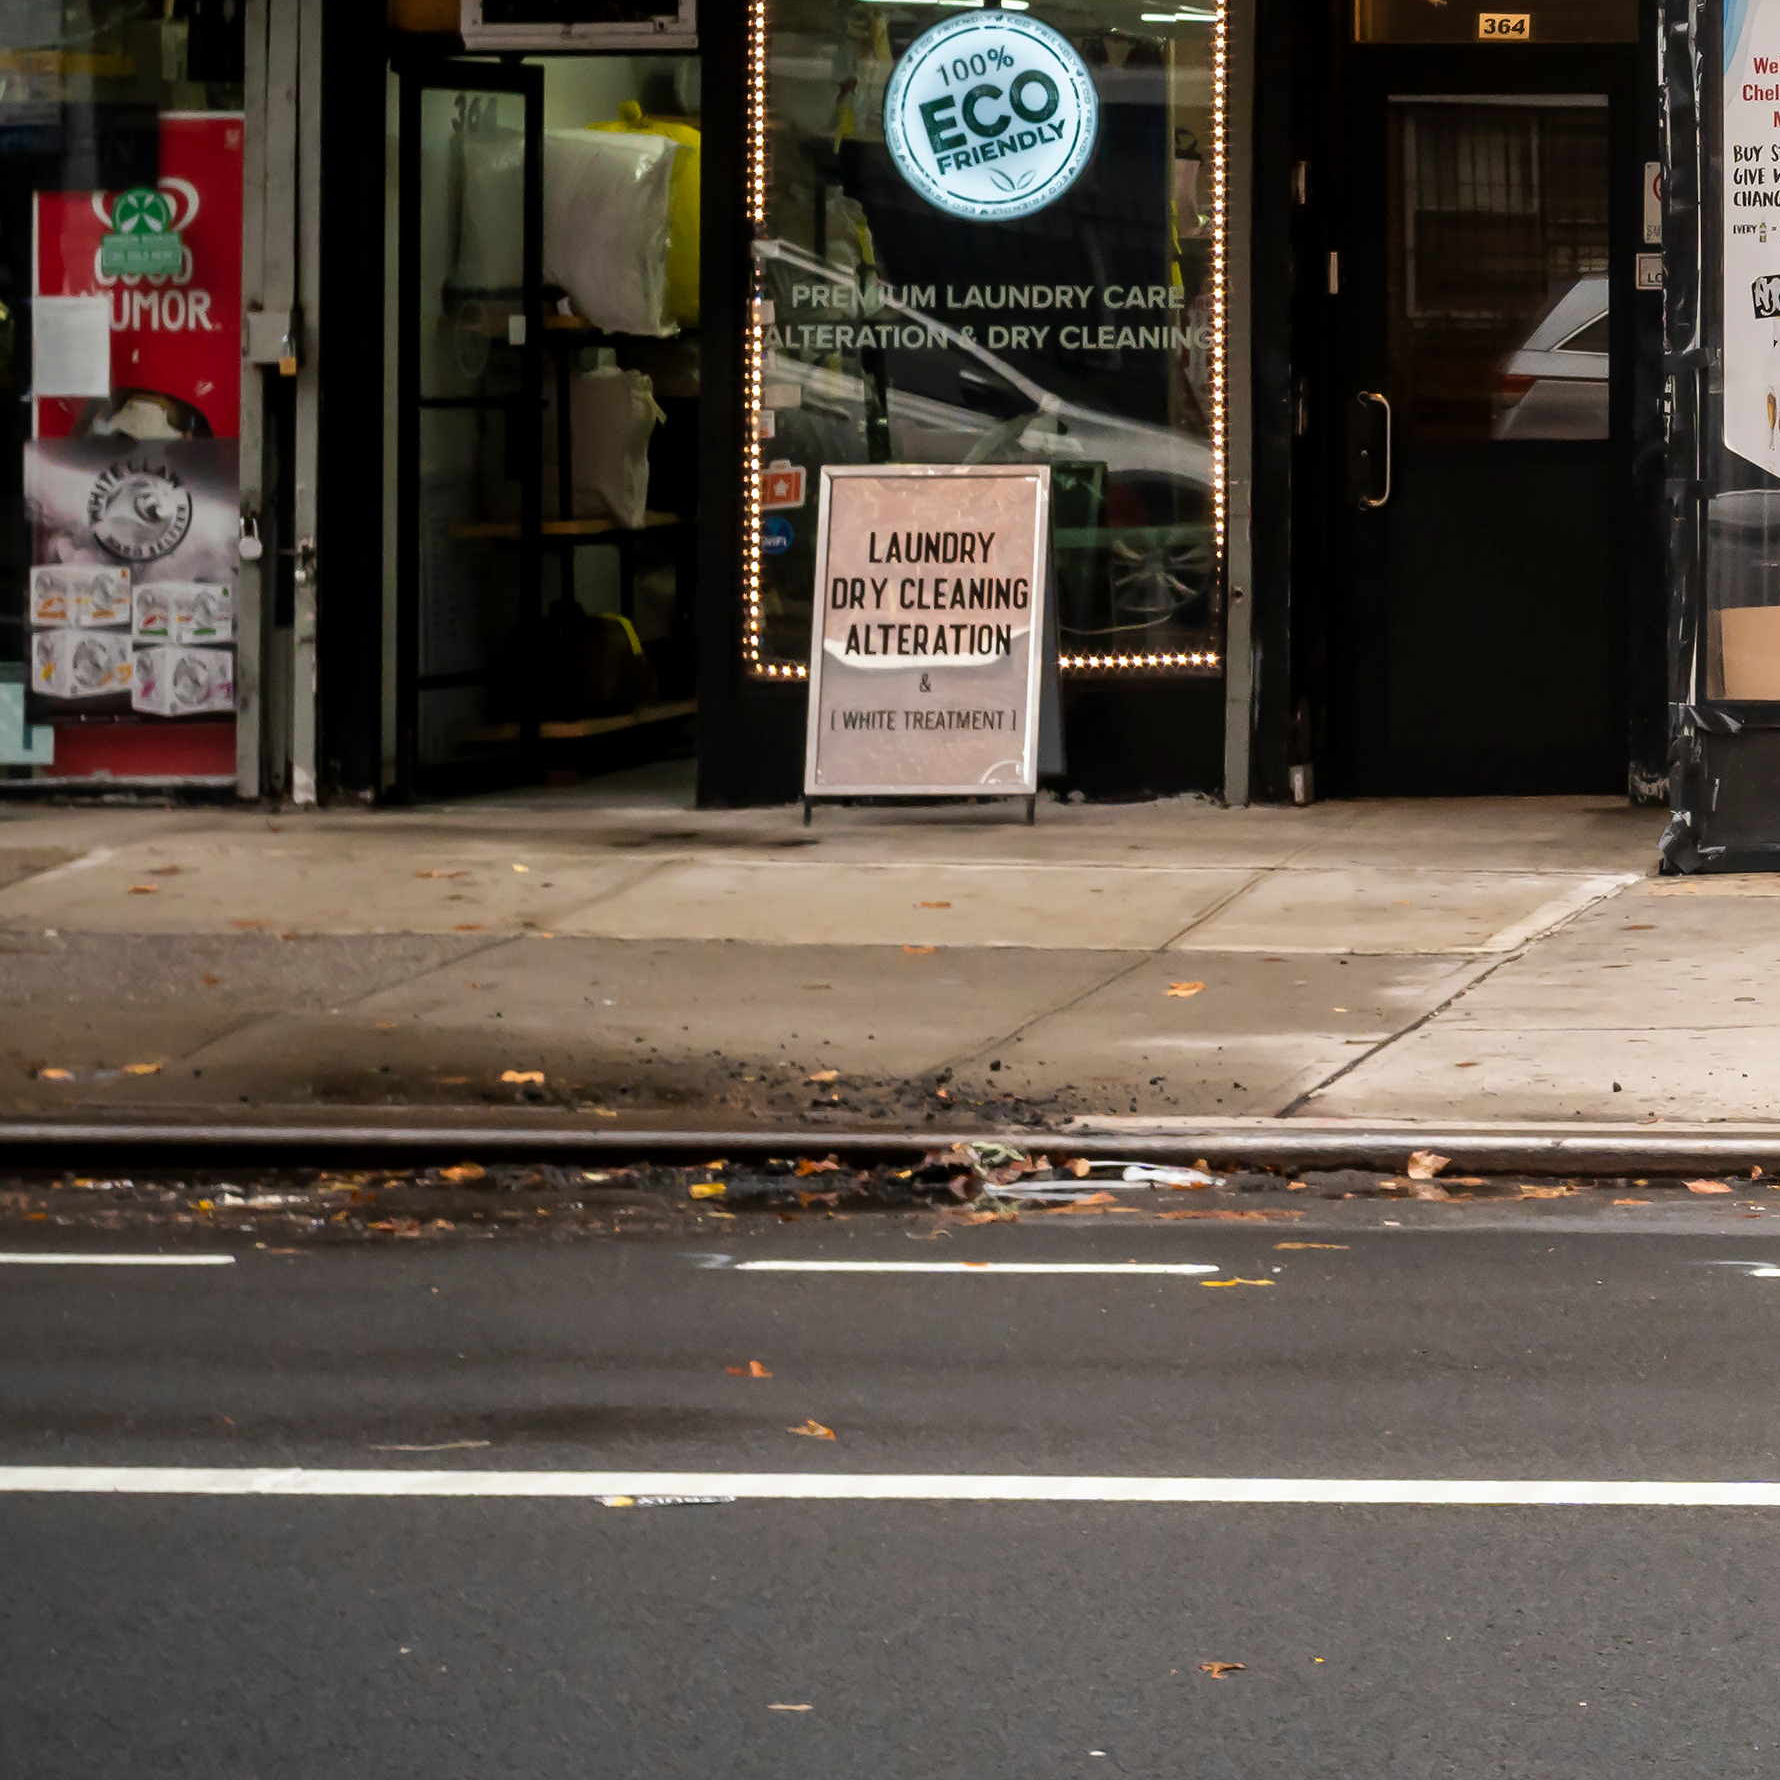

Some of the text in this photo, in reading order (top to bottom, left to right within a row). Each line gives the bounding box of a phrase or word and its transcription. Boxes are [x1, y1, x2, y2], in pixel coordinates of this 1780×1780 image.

[1484, 18, 1525, 35] 364
[937, 45, 1014, 87] 100%
[919, 69, 1060, 154] ECO
[936, 118, 1066, 176] FRIENDLY
[1733, 144, 1763, 163] BUY
[1733, 167, 1766, 185] GIVE
[110, 289, 213, 332] UMOR
[791, 284, 1185, 309] PREMIUM LAUNDRY CARE
[763, 325, 948, 350] ALTERATION
[988, 325, 1049, 350] DRY
[1059, 325, 1213, 350] CLEANING
[869, 531, 996, 564] LAUNDRY
[831, 577, 1029, 611] DRY CLEANING
[845, 623, 1012, 657] ALTERATION
[919, 673, 932, 693] &
[842, 709, 896, 731] WHITE
[904, 709, 1006, 731] TREATMENT
